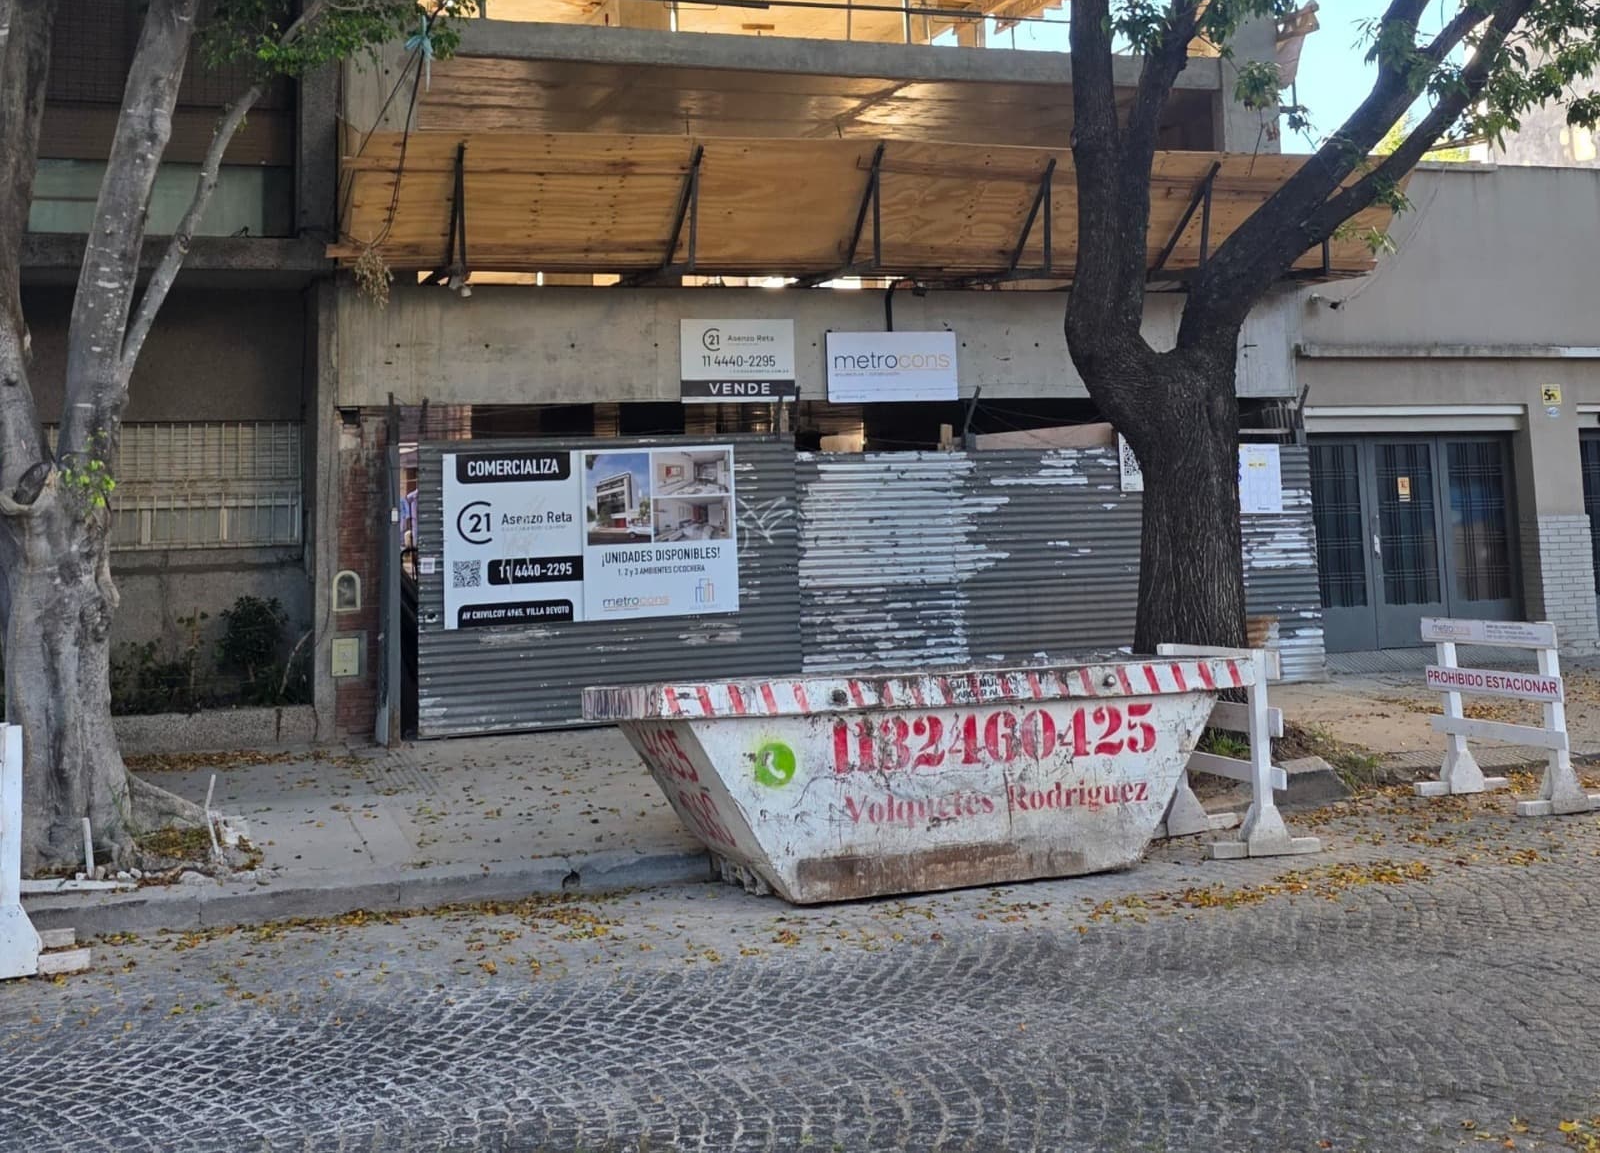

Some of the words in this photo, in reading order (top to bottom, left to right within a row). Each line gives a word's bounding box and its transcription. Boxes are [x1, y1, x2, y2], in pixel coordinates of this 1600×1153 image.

[727, 334, 755, 342] Asenzo
[756, 334, 774, 342] Reta
[702, 354, 711, 367] 11
[713, 354, 776, 368] 4440-2295
[833, 351, 951, 369] metrocons
[708, 382, 771, 395] VENDE
[467, 458, 560, 477] COMERCIALIZA
[501, 512, 543, 525] Asenzo
[546, 511, 573, 524] Reta
[601, 550, 654, 567] ¡UNIDADES
[655, 546, 721, 562] DISPONIBLES!
[499, 565, 512, 580] 11
[514, 562, 573, 578] 4440-2295
[624, 568, 629, 576] 2
[629, 569, 634, 577] y
[634, 567, 639, 575] 3
[640, 566, 673, 575] AMBIENTES
[602, 595, 672, 608] metrocons
[472, 608, 506, 620] CHIVILCOY
[526, 605, 545, 616] VILLA
[546, 605, 570, 615] DEVOTO
[1427, 670, 1483, 687] PROHIBIDO
[1485, 675, 1558, 694] ESTACIONAR
[832, 703, 1157, 775] 1132460425
[844, 792, 995, 829] Volquetes
[1008, 778, 1150, 814] Rodriguez
